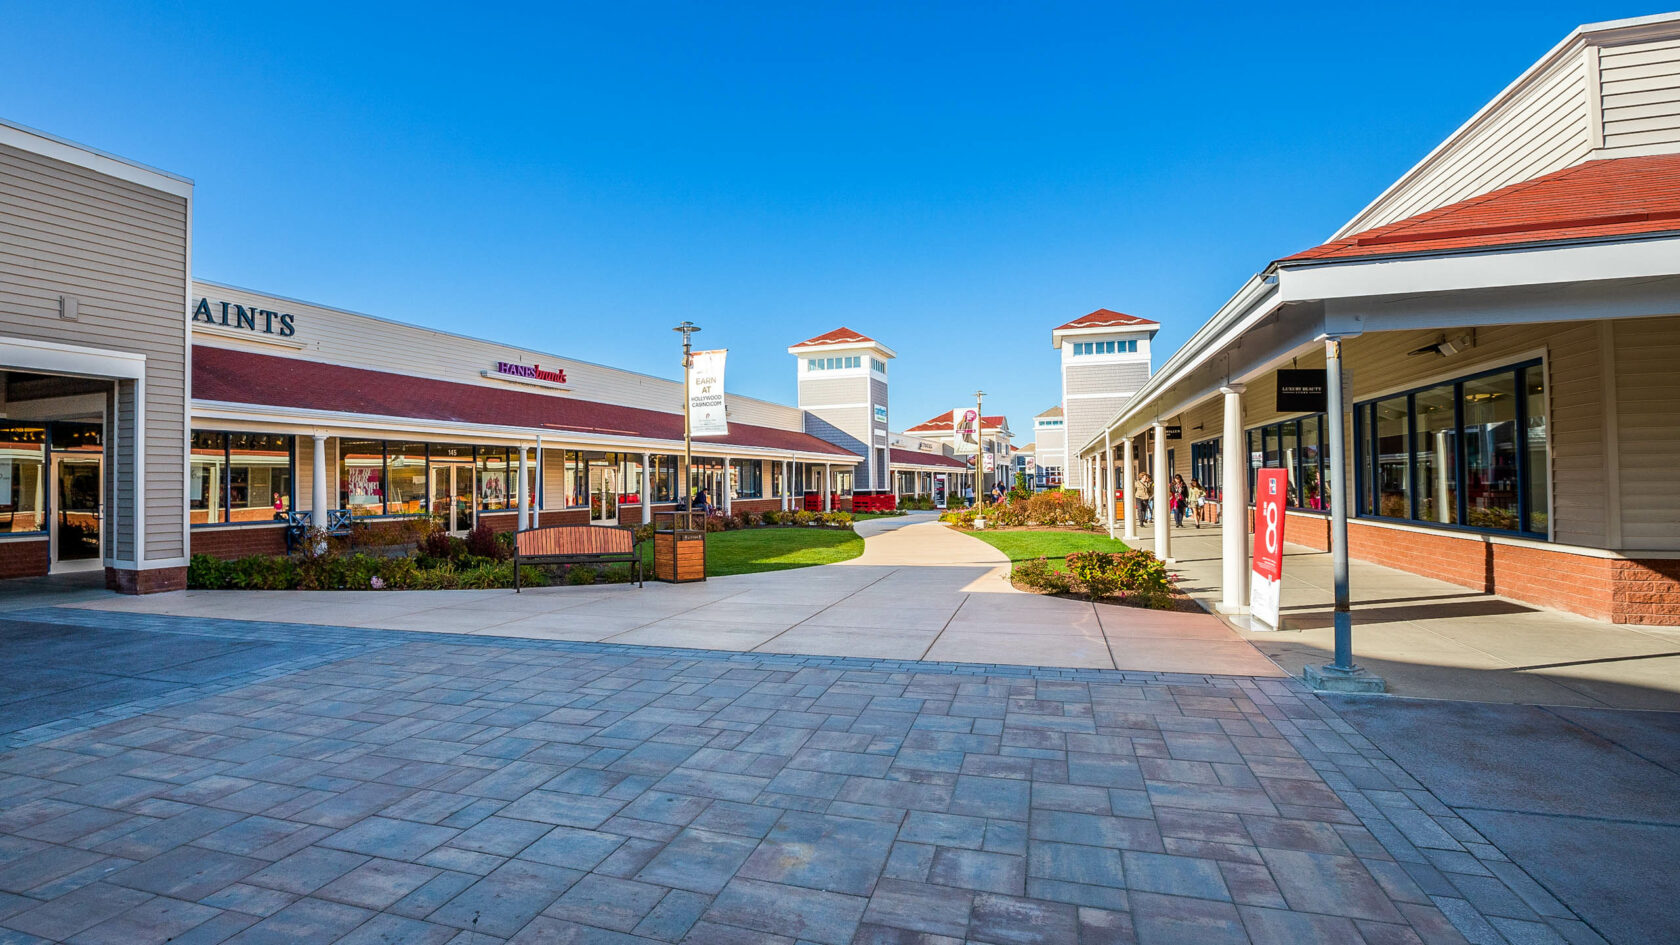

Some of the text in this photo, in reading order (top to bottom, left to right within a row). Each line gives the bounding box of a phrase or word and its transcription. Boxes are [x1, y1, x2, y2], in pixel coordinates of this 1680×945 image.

[192, 298, 296, 337] AINTS
[696, 377, 716, 385] EARN
[702, 386, 711, 394] AT
[691, 394, 722, 402] HOLLYWOOD
